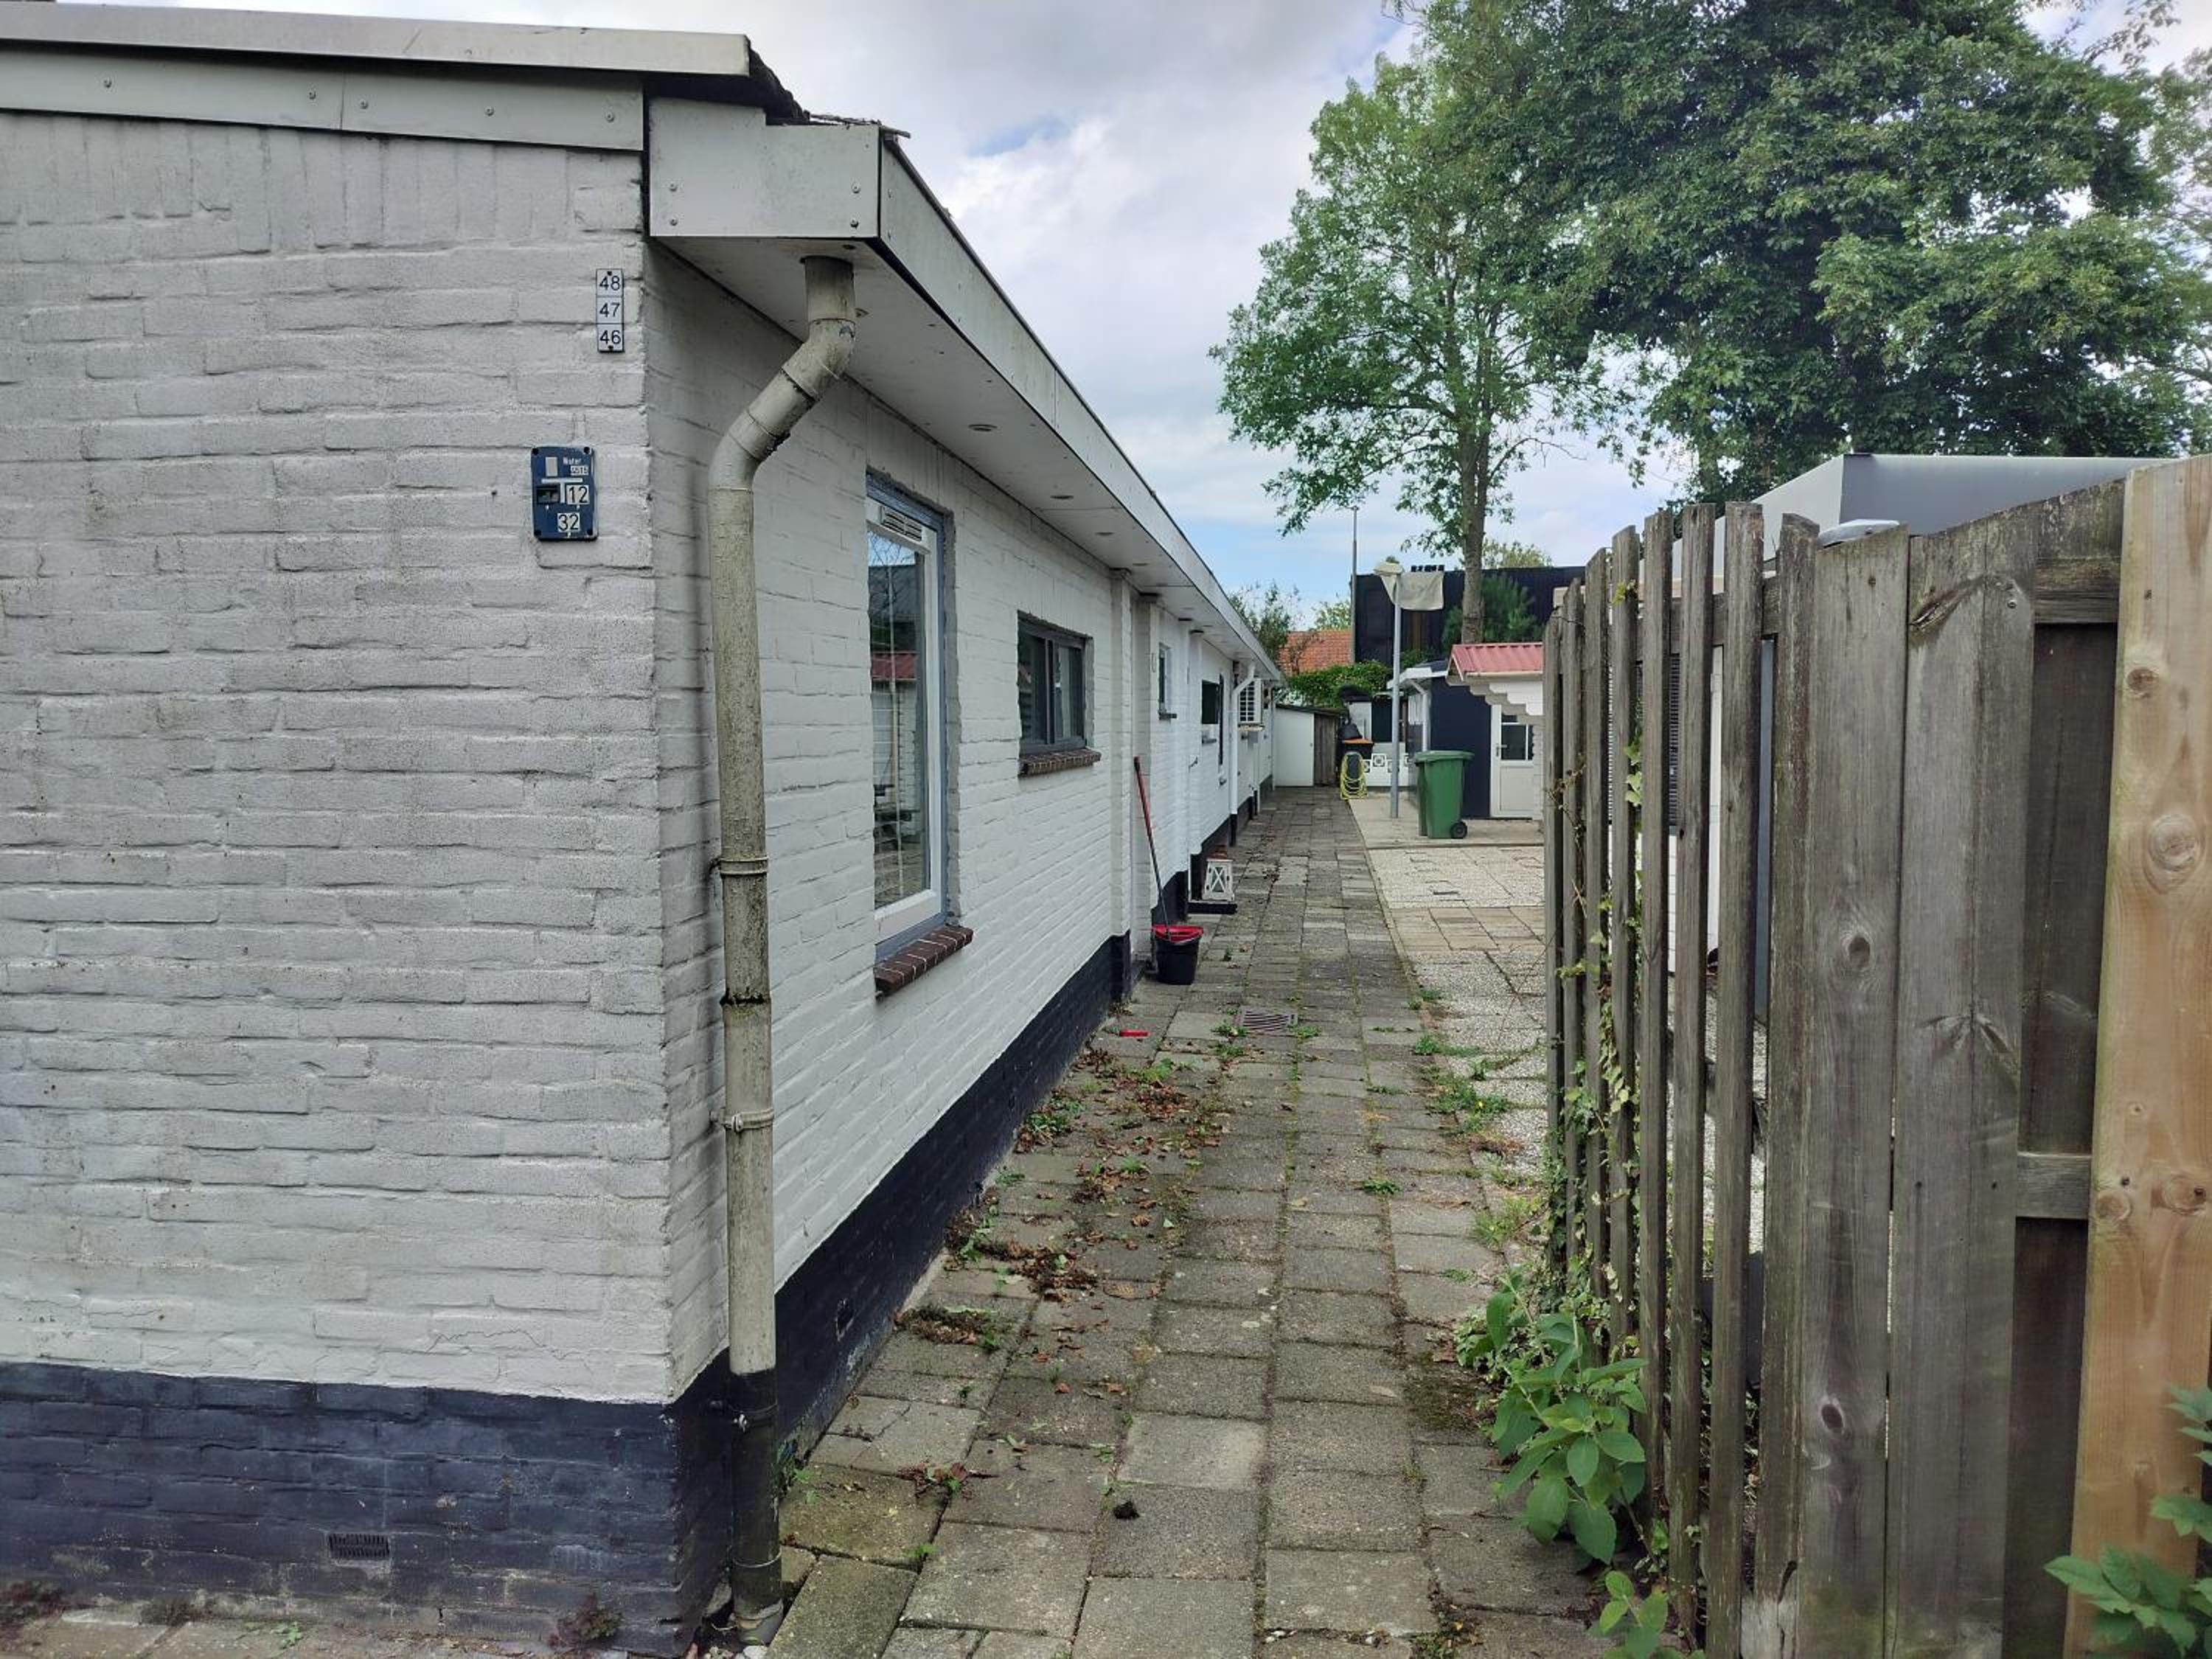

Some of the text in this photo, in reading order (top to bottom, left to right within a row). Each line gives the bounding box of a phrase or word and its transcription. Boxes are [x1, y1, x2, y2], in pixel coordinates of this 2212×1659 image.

[599, 275, 621, 291] 48
[599, 302, 621, 318] 47
[599, 330, 622, 345] 46
[568, 486, 588, 504] 12
[558, 514, 579, 531] 32
